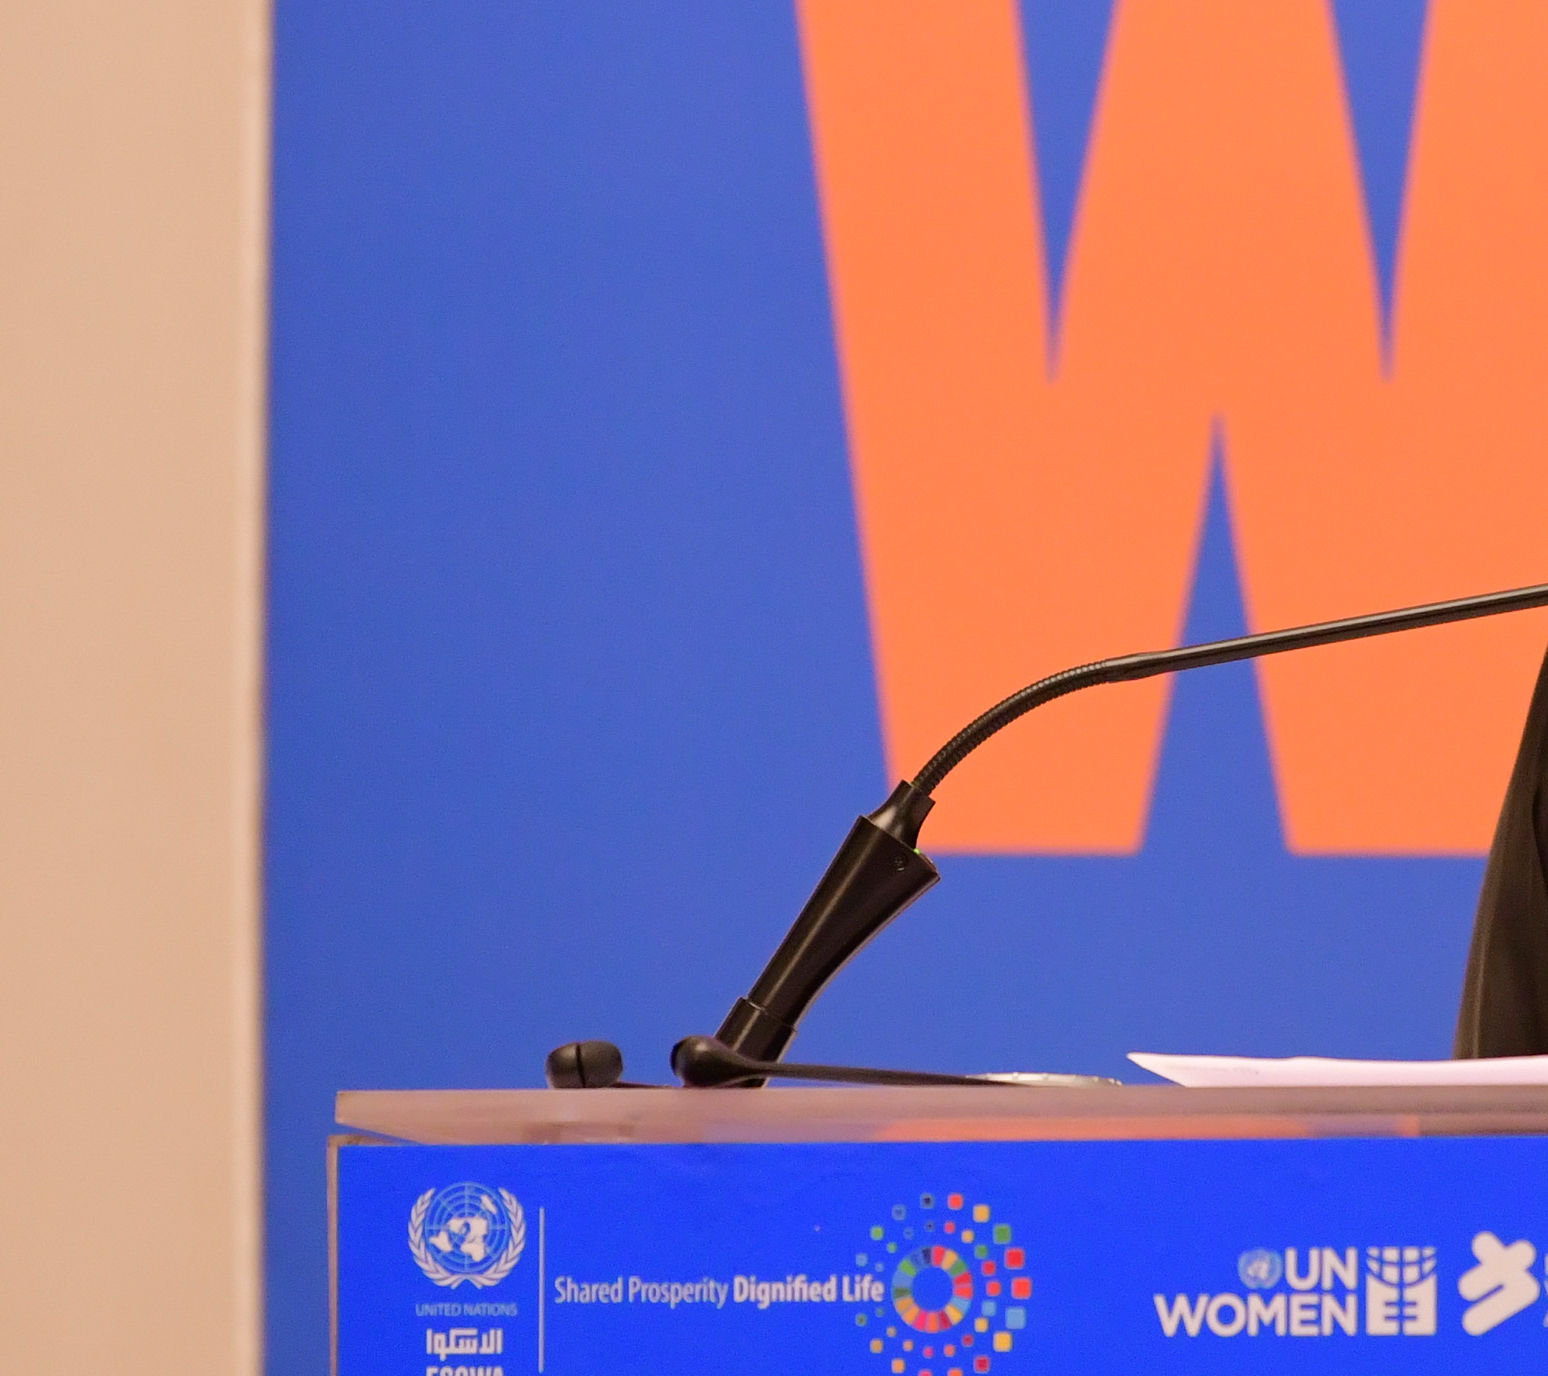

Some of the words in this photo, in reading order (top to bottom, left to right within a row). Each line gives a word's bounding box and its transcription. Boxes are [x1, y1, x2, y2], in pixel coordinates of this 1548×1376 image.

[1287, 1249, 1356, 1289] UN
[416, 1303, 462, 1316] UNITED
[464, 1303, 517, 1316] NATIONS
[555, 1276, 623, 1303] Shared
[629, 1276, 728, 1308] Prosperity
[734, 1275, 836, 1308] Dignified
[843, 1275, 884, 1301] Life
[1155, 1295, 1356, 1336] WOMEN
